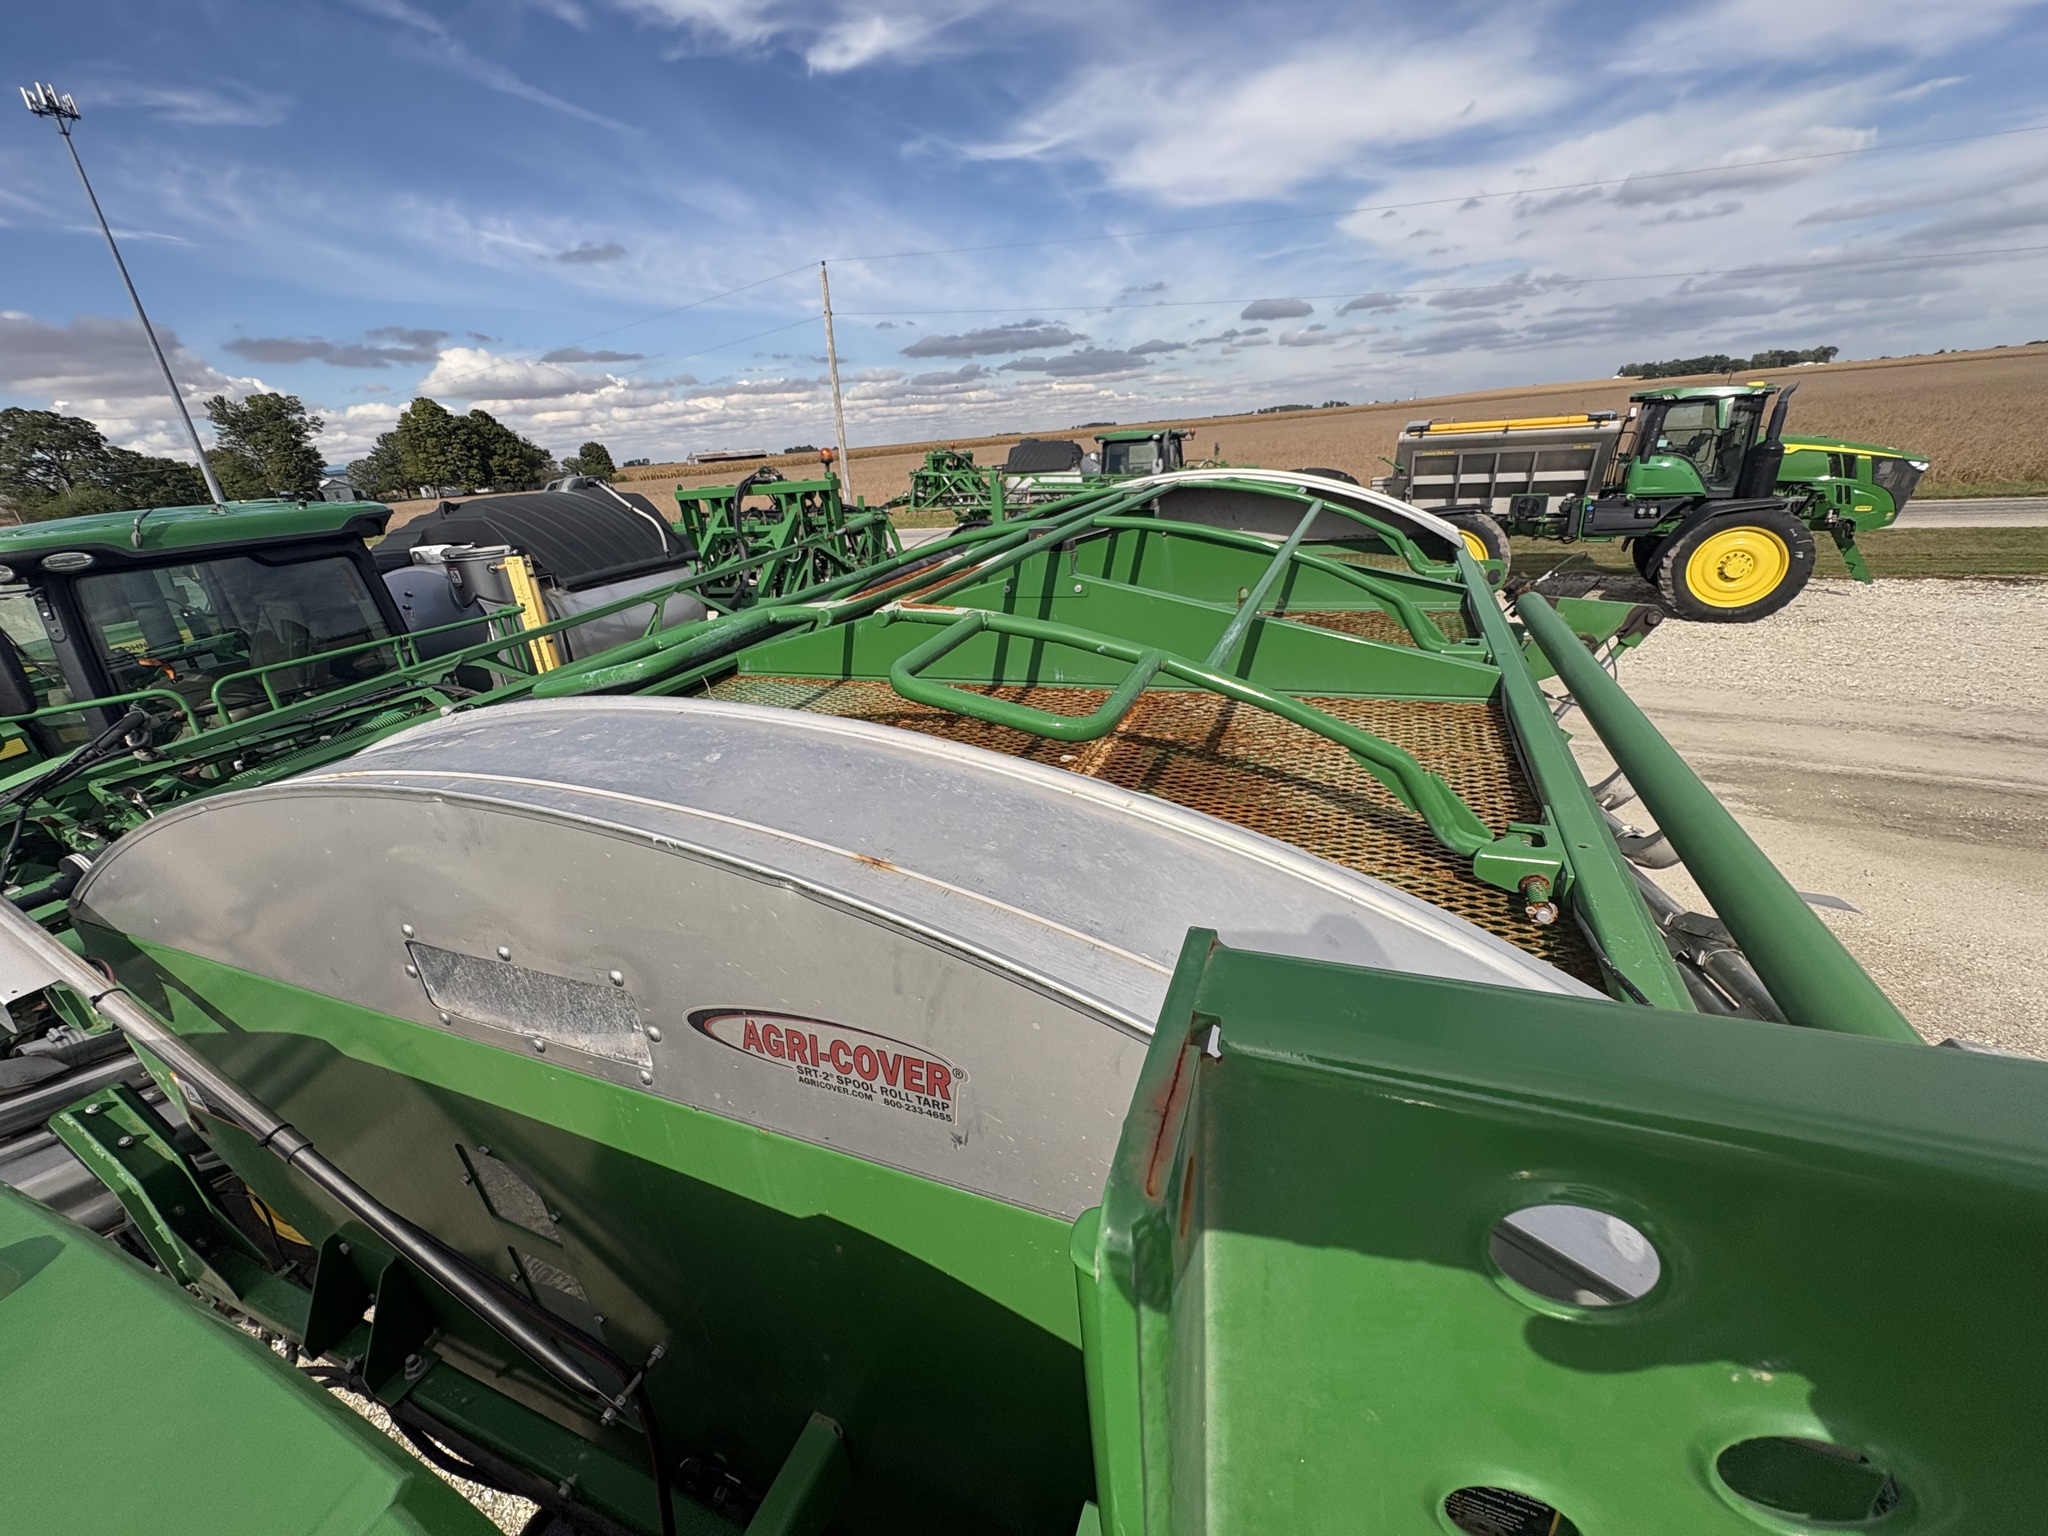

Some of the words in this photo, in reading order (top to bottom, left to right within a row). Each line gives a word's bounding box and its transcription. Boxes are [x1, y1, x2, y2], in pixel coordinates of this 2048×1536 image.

[799, 1076, 873, 1101] AGRICOVER.COM
[883, 1098, 952, 1123] 800-233-4655
[837, 1075, 877, 1093] SPOOL
[880, 1086, 913, 1103] ROLL
[915, 1095, 950, 1112] TARP
